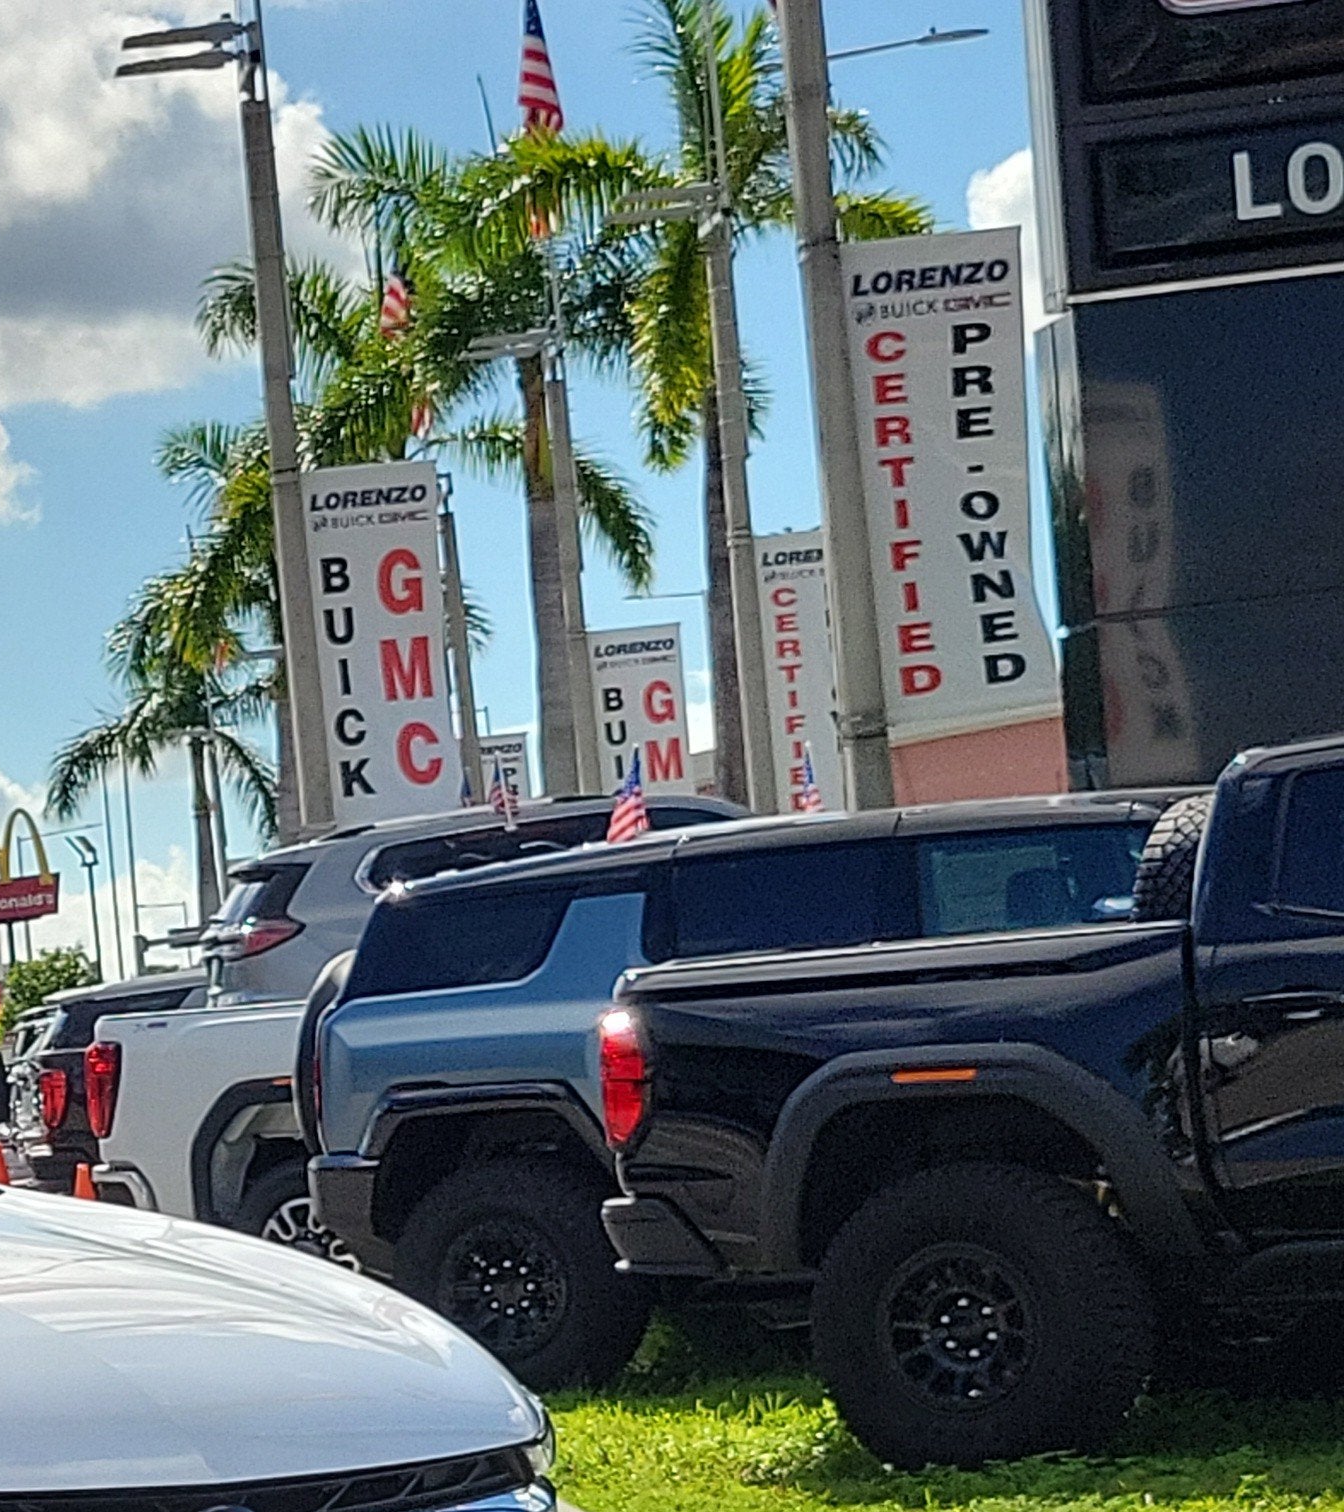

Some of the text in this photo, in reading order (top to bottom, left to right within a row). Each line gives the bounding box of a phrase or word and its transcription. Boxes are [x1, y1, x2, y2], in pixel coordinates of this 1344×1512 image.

[1233, 142, 1344, 220] LO
[851, 259, 1009, 296] LORENZO
[880, 300, 937, 319] BUICK
[310, 484, 427, 511] LORENZO
[331, 515, 375, 529] BUICK
[864, 330, 942, 697] CERTIFIED
[377, 548, 444, 786] GMC
[594, 638, 674, 658] LORENZO
[319, 557, 376, 797] BUICK
[643, 680, 683, 782] GM
